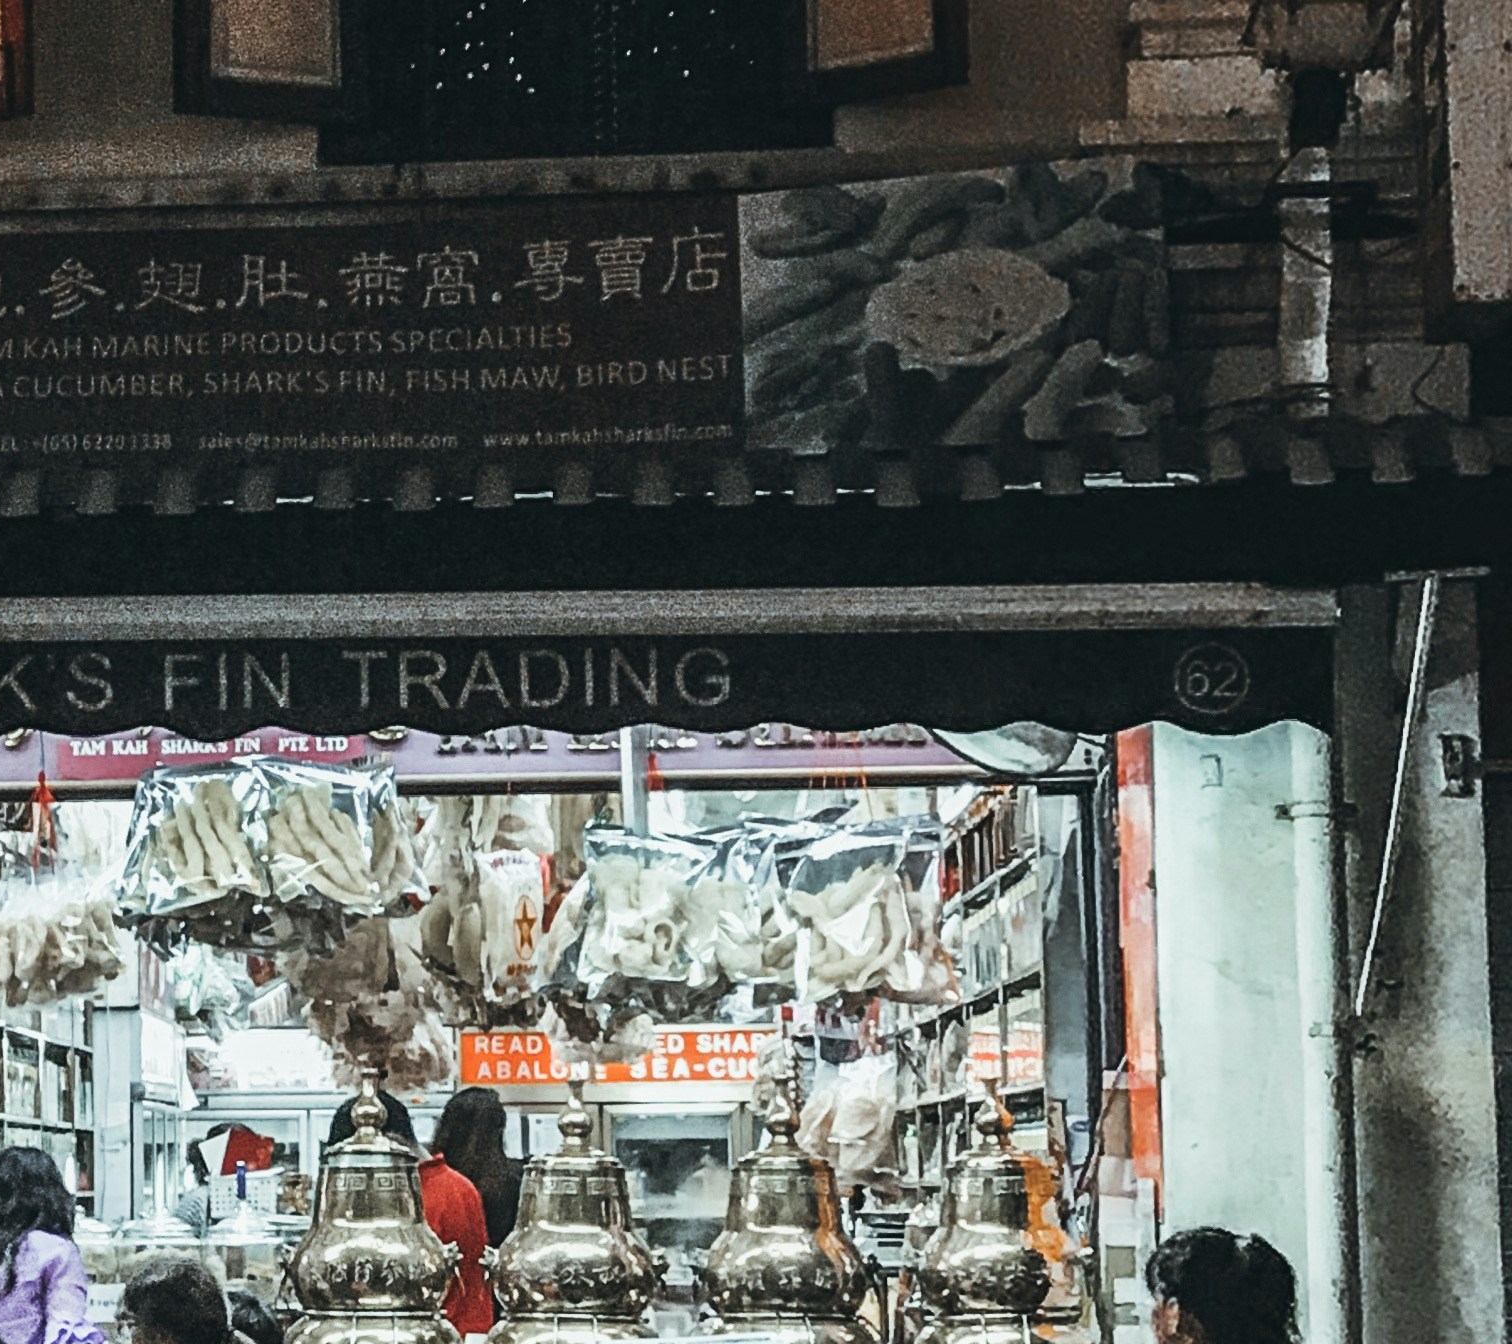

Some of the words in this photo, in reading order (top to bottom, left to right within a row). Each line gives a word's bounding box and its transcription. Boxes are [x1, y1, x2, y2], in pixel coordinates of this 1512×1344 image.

[22, 335, 84, 361] KAH
[92, 333, 211, 360] MARINE
[220, 329, 384, 356] PRODUCTS
[389, 323, 573, 353] SPECIALTIES
[11, 373, 194, 401] CUCUMBER,
[202, 369, 332, 396] SHARK'S
[337, 368, 393, 395] FIN,
[403, 367, 466, 392] FISH
[478, 364, 566, 392] MAW,
[575, 359, 650, 388] BIRD
[656, 355, 733, 384] NEST
[482, 422, 734, 448] www.tamkahsharksfin.com
[165, 651, 289, 712] FIN
[356, 647, 732, 712] TRADING
[1185, 659, 1240, 700] 62
[71, 739, 105, 755] TAM
[112, 738, 148, 755] KAH
[235, 736, 261, 753] FIN
[278, 736, 309, 753] PTE
[316, 736, 348, 752] LTD
